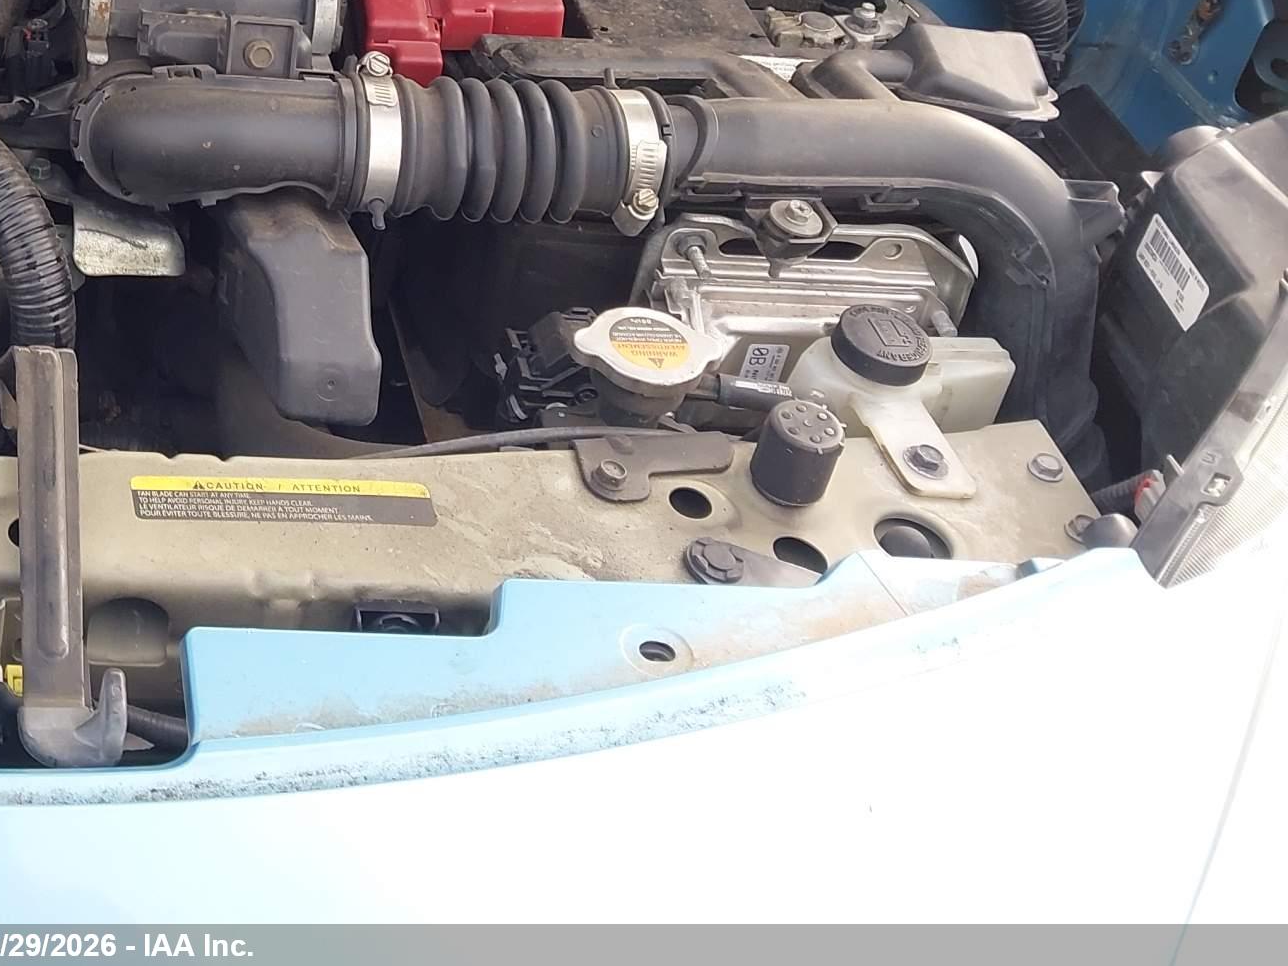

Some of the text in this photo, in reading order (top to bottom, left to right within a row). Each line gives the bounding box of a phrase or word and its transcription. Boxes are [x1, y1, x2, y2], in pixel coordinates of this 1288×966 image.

[206, 481, 264, 491] CAUTION
[292, 484, 361, 493] ATTENTION
[140, 509, 162, 517] POUR
